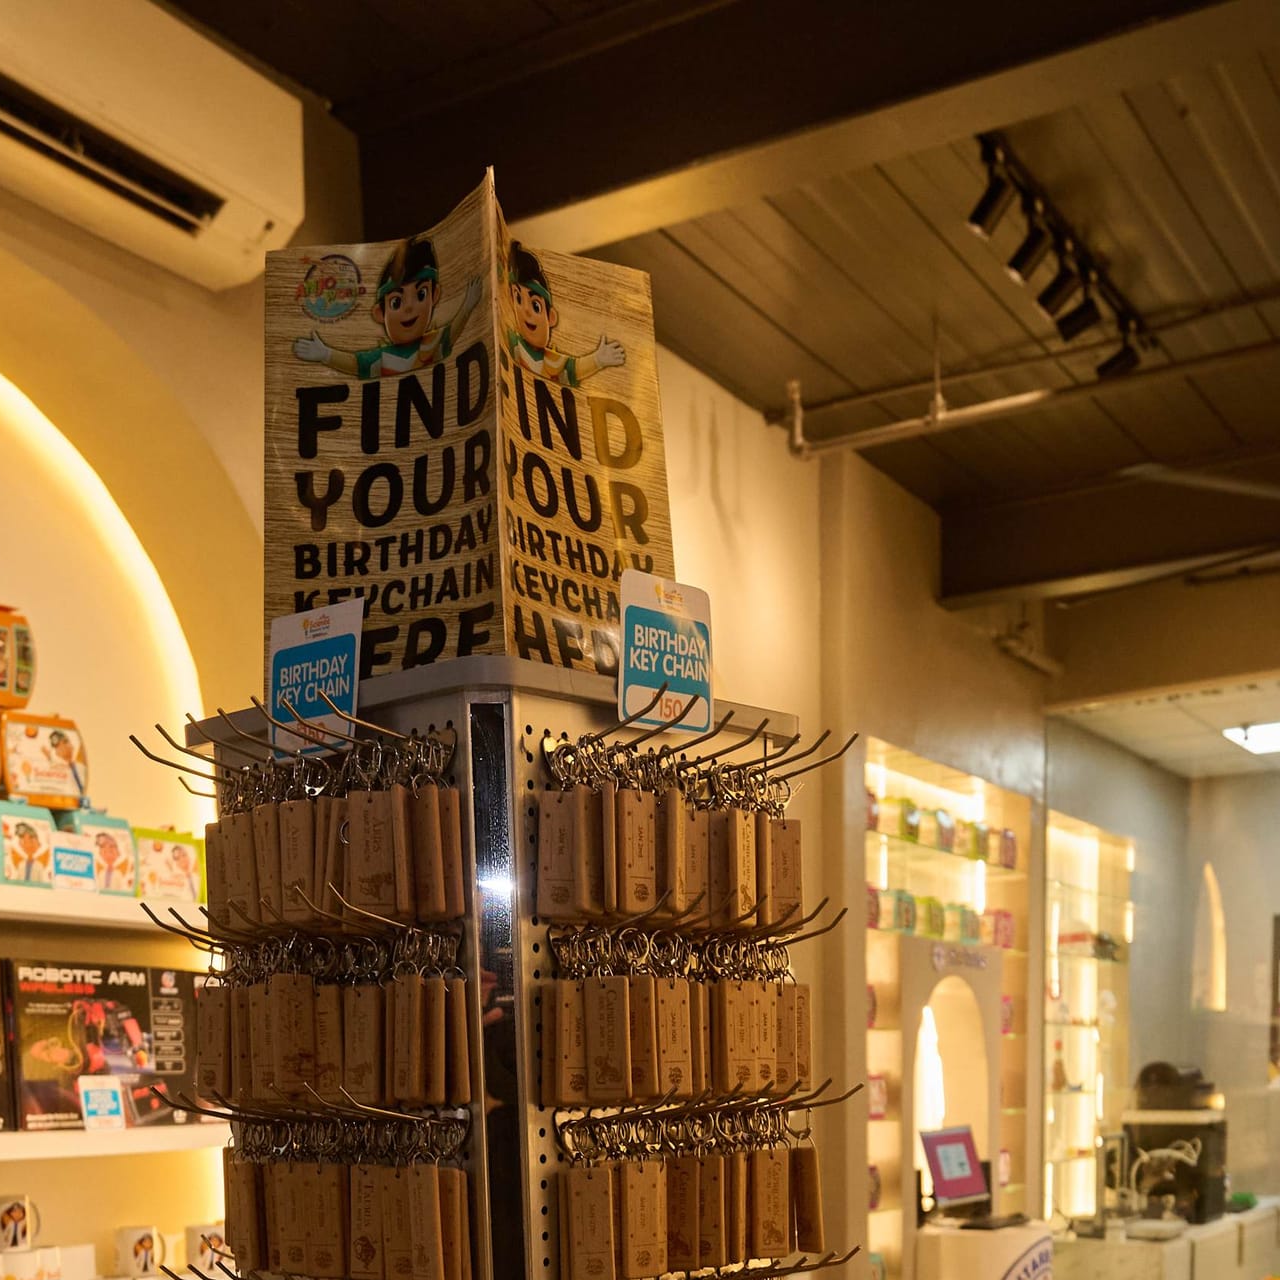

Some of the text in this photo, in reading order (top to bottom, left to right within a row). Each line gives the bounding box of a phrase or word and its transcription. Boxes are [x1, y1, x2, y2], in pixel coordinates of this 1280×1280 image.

[295, 341, 490, 459] FIND
[294, 429, 491, 531] YOUR
[503, 437, 650, 545] YOUR
[294, 504, 492, 580] BIRTHDAY
[510, 559, 620, 622] KEYCHA
[280, 653, 348, 687] BIRTHDAY
[362, 602, 494, 679] ERE
[630, 647, 709, 683] KEY CHAIN
[634, 624, 706, 660] BIRTHDAY
[277, 675, 350, 708] KEY CHAIN
[18, 966, 146, 987] ROBOTIC ARM
